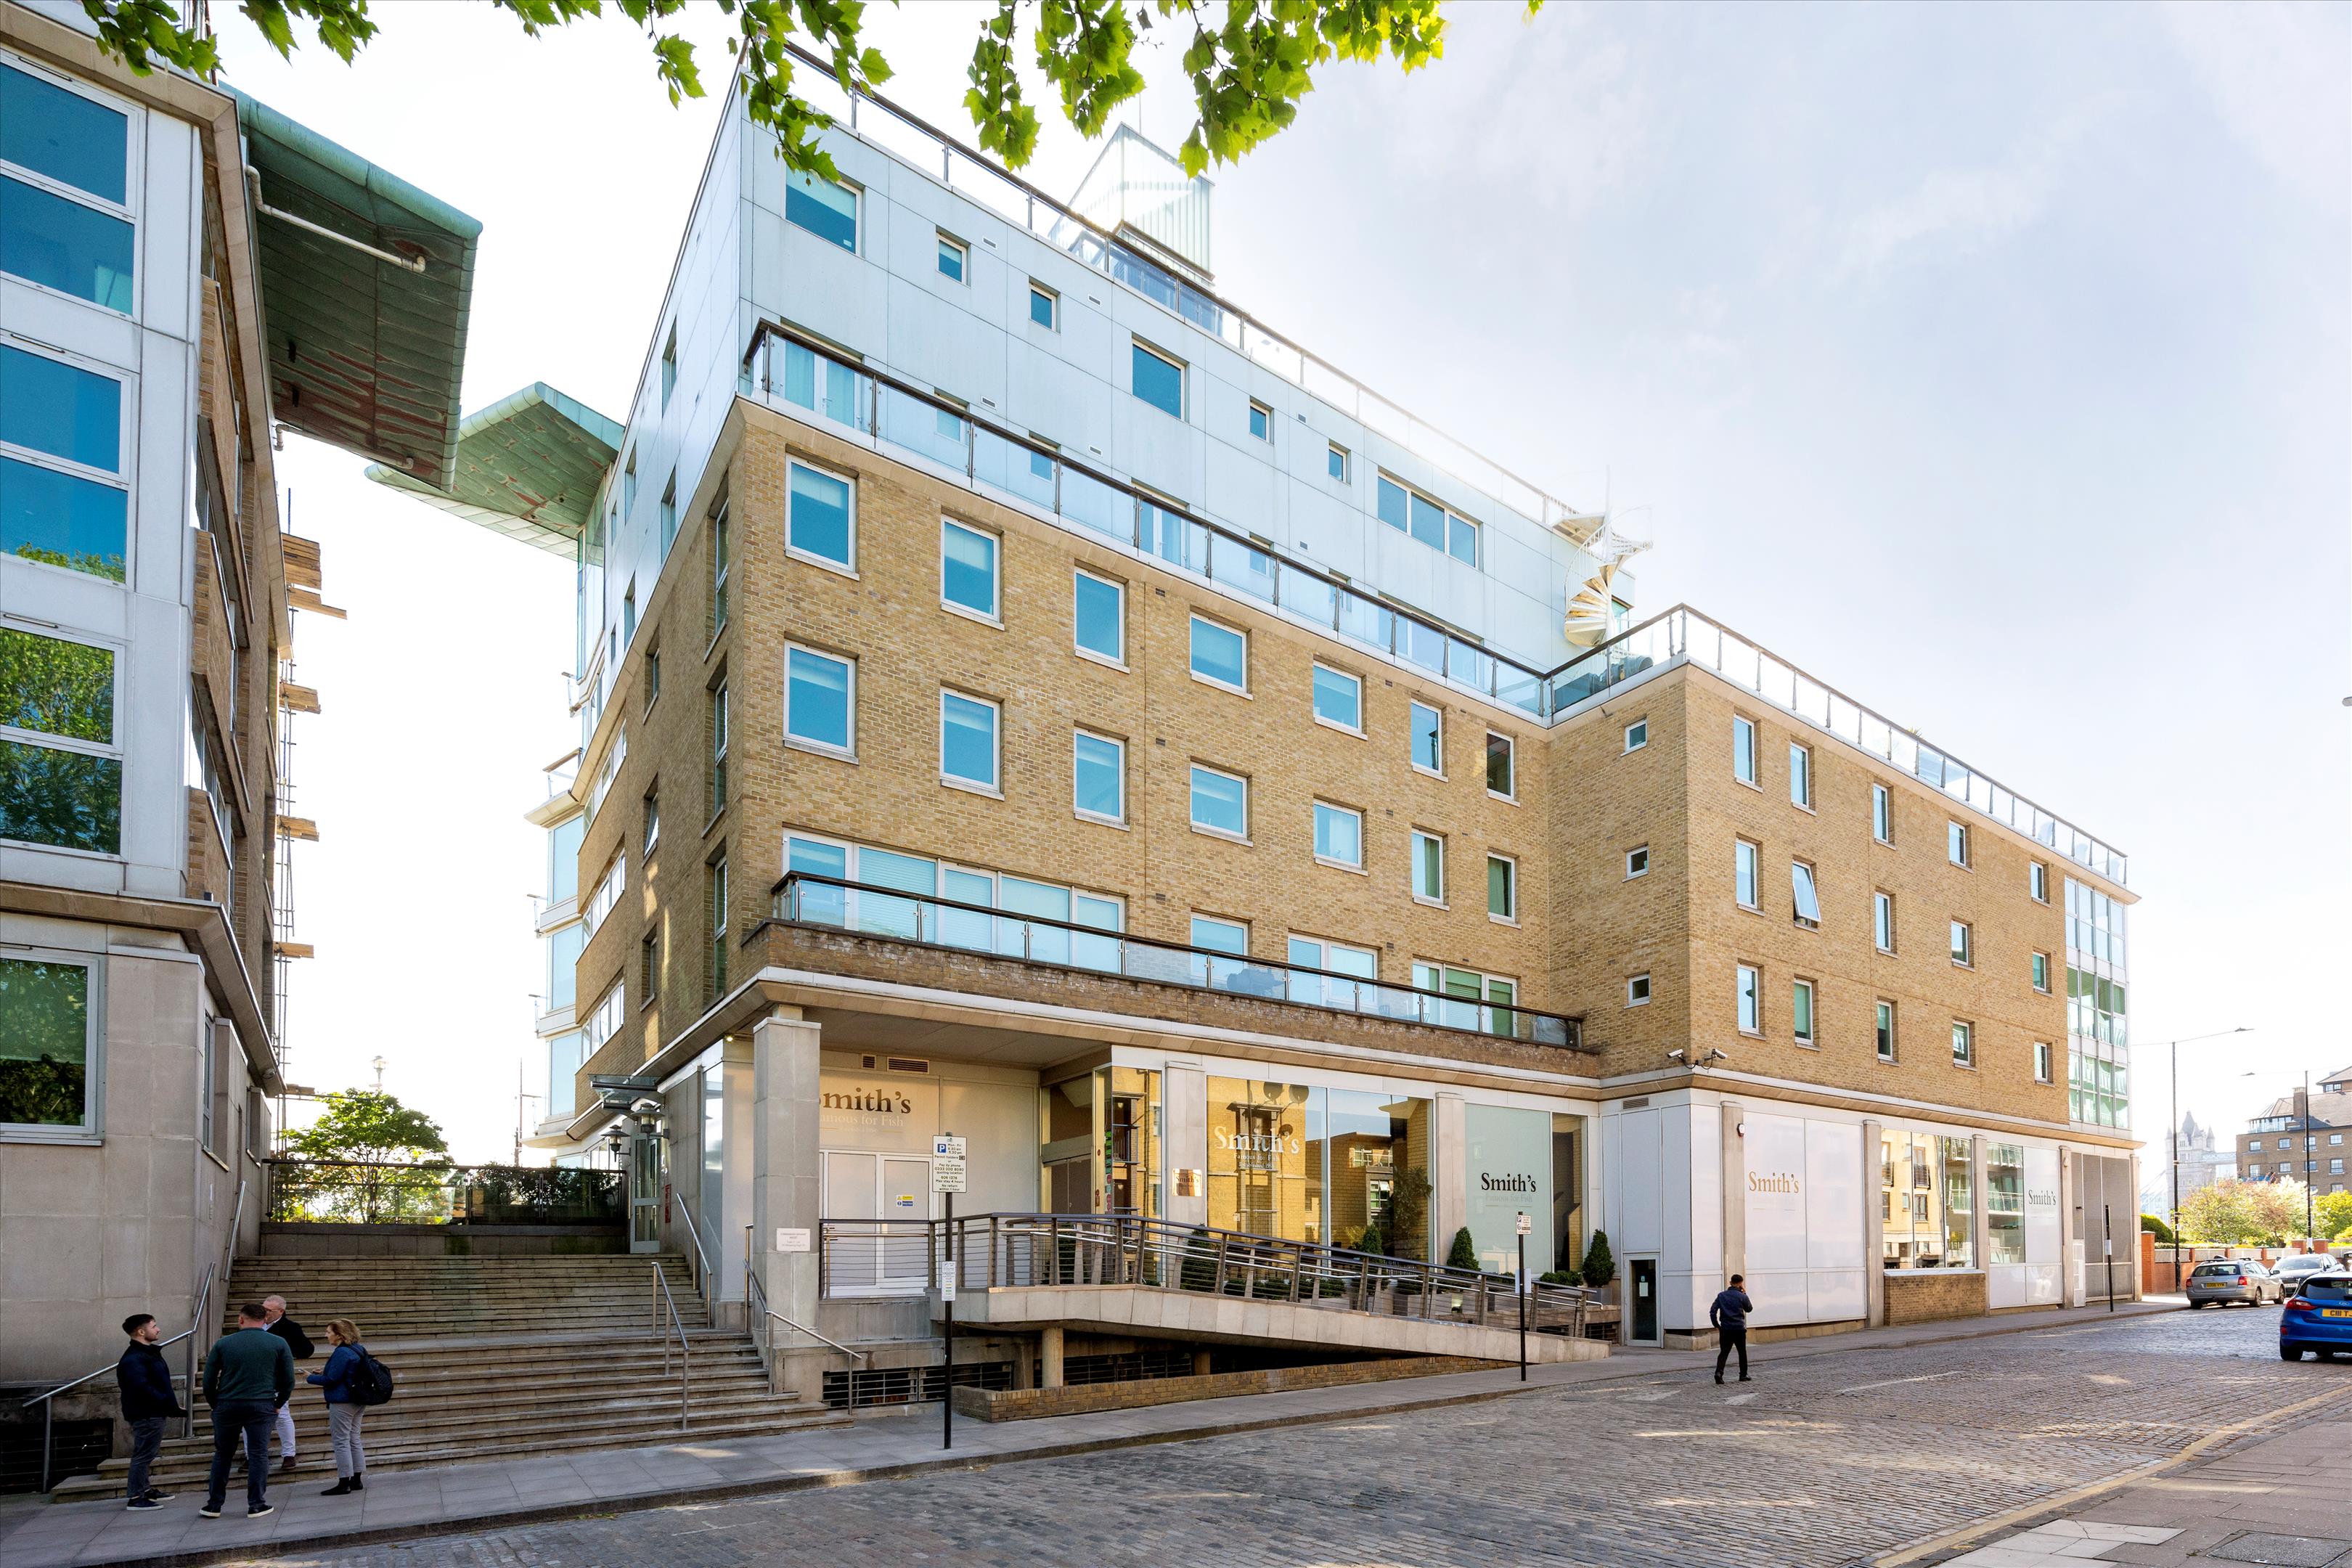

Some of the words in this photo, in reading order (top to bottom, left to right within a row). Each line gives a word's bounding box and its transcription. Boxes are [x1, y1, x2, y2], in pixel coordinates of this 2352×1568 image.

[819, 1087, 911, 1114] mith's
[820, 1114, 857, 1124] amous
[861, 1114, 878, 1125] for
[881, 1115, 904, 1127] Fish
[1214, 1125, 1300, 1154] Smith's
[1481, 1172, 1536, 1193] Smith's
[1749, 1171, 1800, 1193] Smith's
[2028, 1189, 2057, 1206] Smith's
